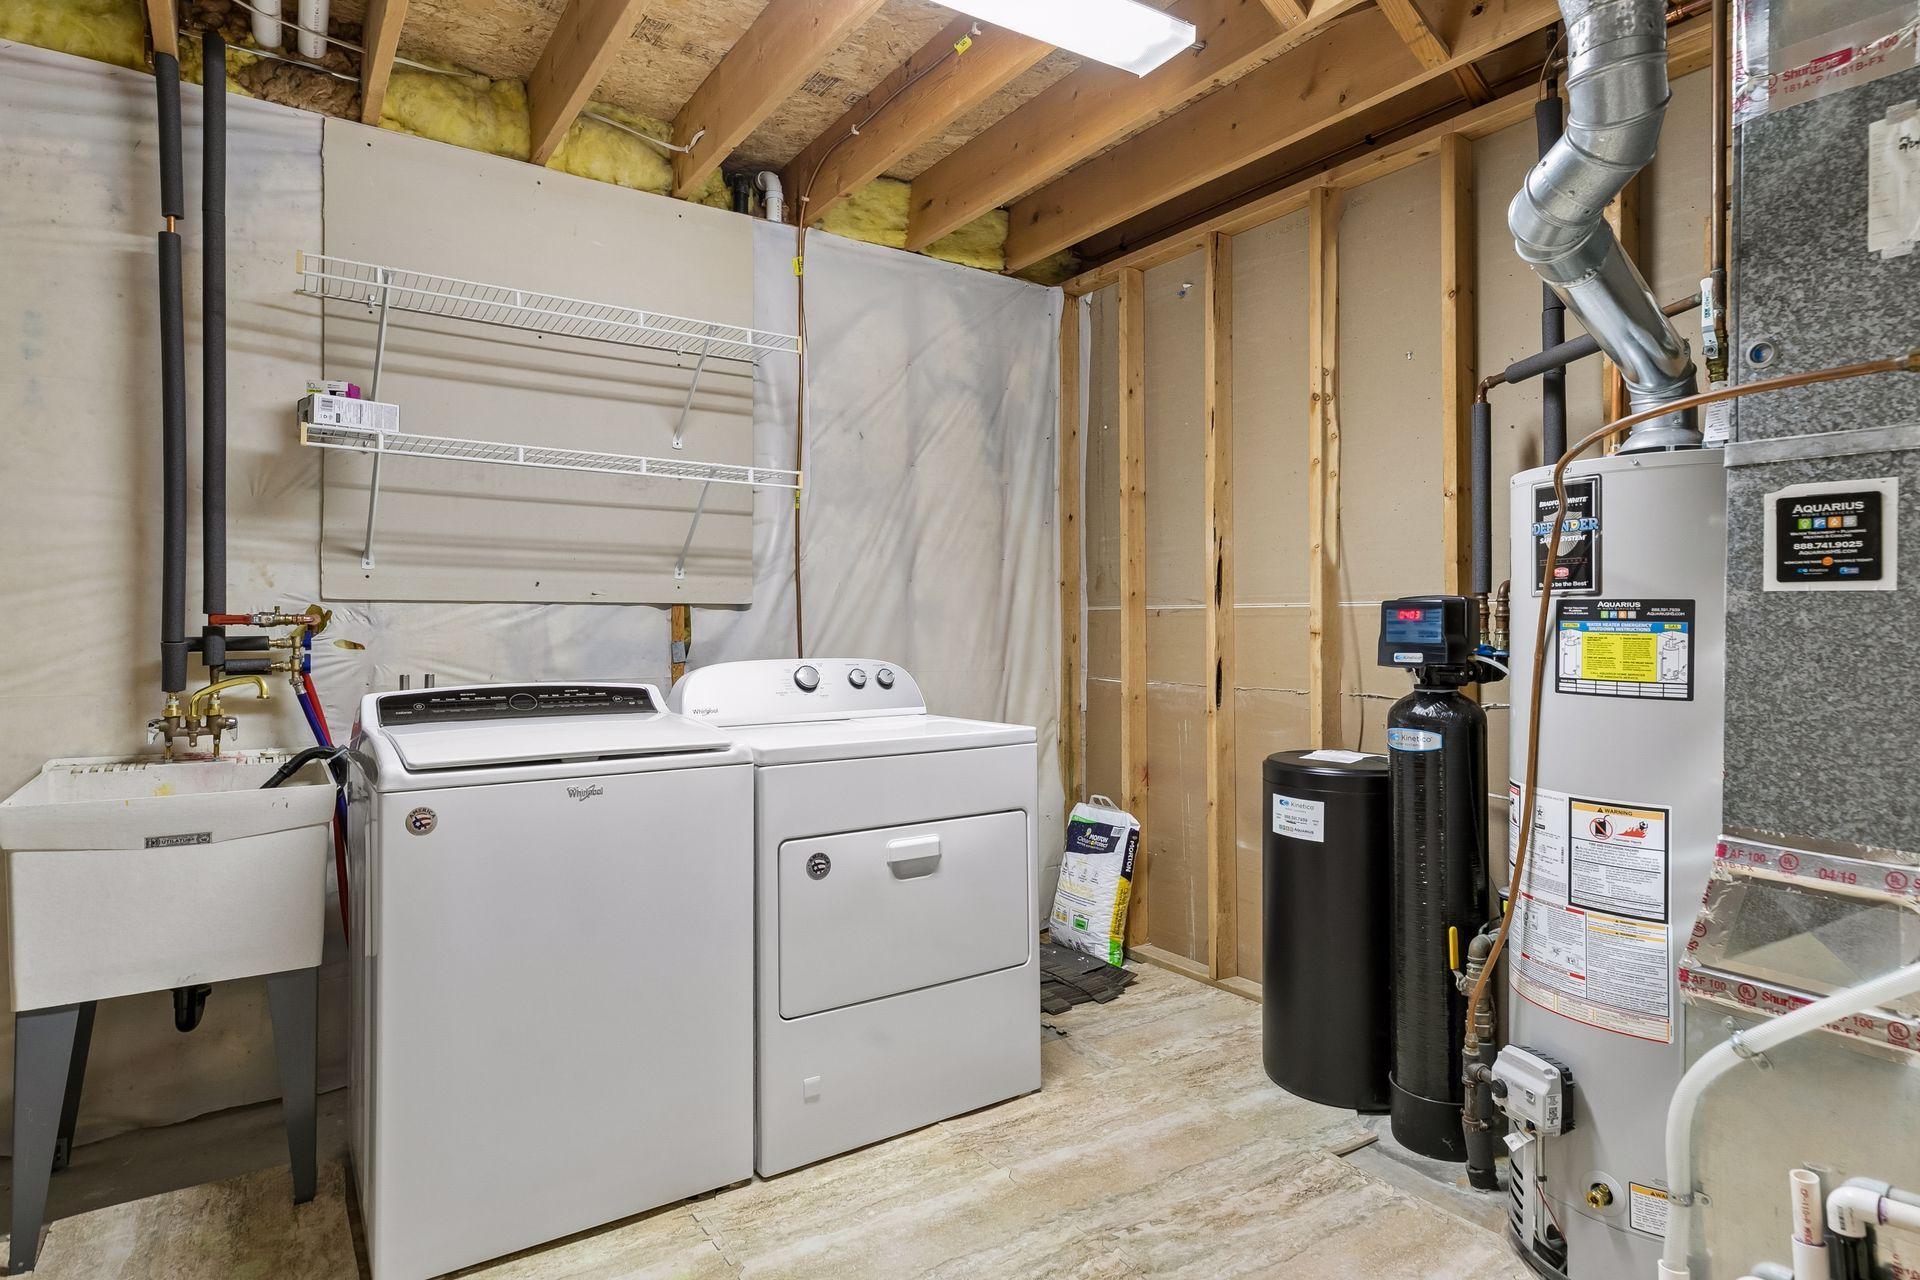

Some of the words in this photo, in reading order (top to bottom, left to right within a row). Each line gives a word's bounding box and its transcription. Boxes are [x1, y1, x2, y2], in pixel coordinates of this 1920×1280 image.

[1783, 75, 1825, 95] 181A-P
[1792, 501, 1864, 514] AQUARIUS
[1532, 517, 1599, 536] DEFNDER
[1793, 540, 1864, 550] 888.741.9025
[567, 784, 604, 801] Whirlpool
[1291, 800, 1315, 811] Kinetico
[1604, 806, 1633, 817] WARNING
[1125, 840, 1135, 873] MORTON
[1729, 849, 1744, 860] AF
[1748, 852, 1767, 864] 100
[1691, 975, 1706, 986] AF
[1710, 979, 1728, 992] 100
[1852, 1016, 1874, 1030] 100
